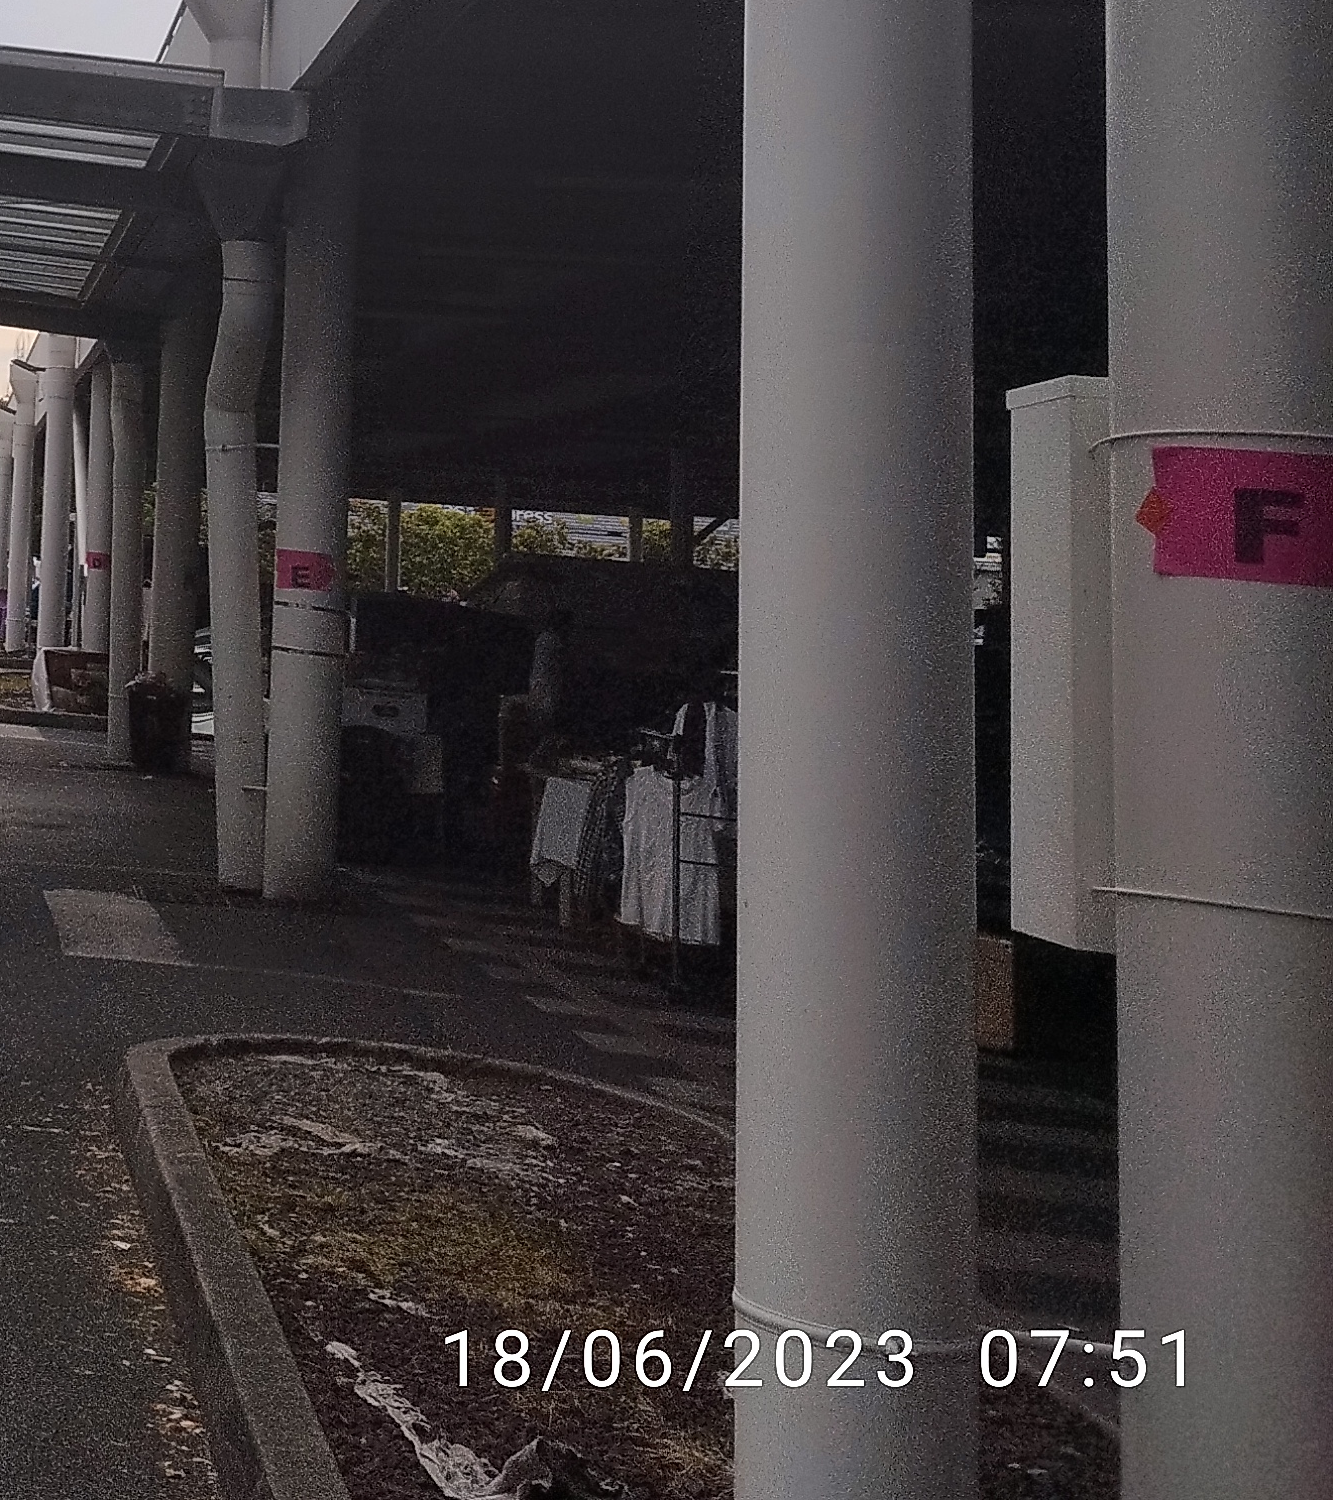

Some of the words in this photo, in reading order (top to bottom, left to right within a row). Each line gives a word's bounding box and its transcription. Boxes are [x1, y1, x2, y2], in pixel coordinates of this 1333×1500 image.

[513, 510, 553, 523] ress
[1234, 488, 1304, 564] F
[291, 566, 310, 589] E
